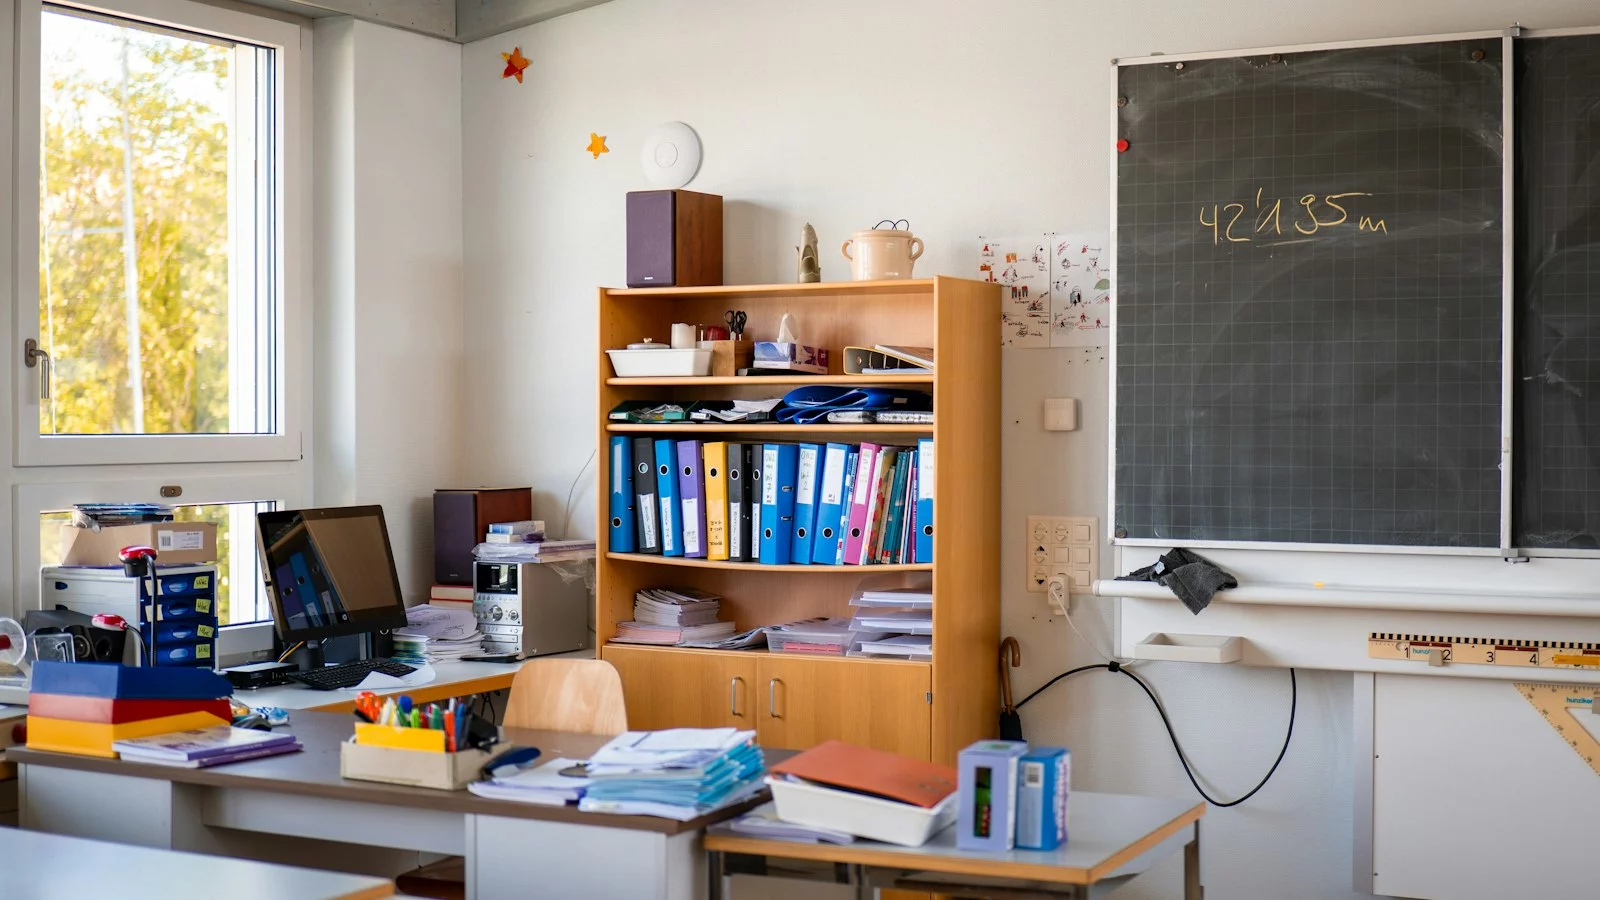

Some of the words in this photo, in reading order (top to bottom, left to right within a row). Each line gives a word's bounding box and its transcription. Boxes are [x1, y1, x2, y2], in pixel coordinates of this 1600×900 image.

[1359, 215, 1388, 235] m
[1404, 647, 1409, 658] 1
[1442, 649, 1451, 661] 2
[1486, 651, 1494, 663] 3
[1529, 653, 1538, 665] 4
